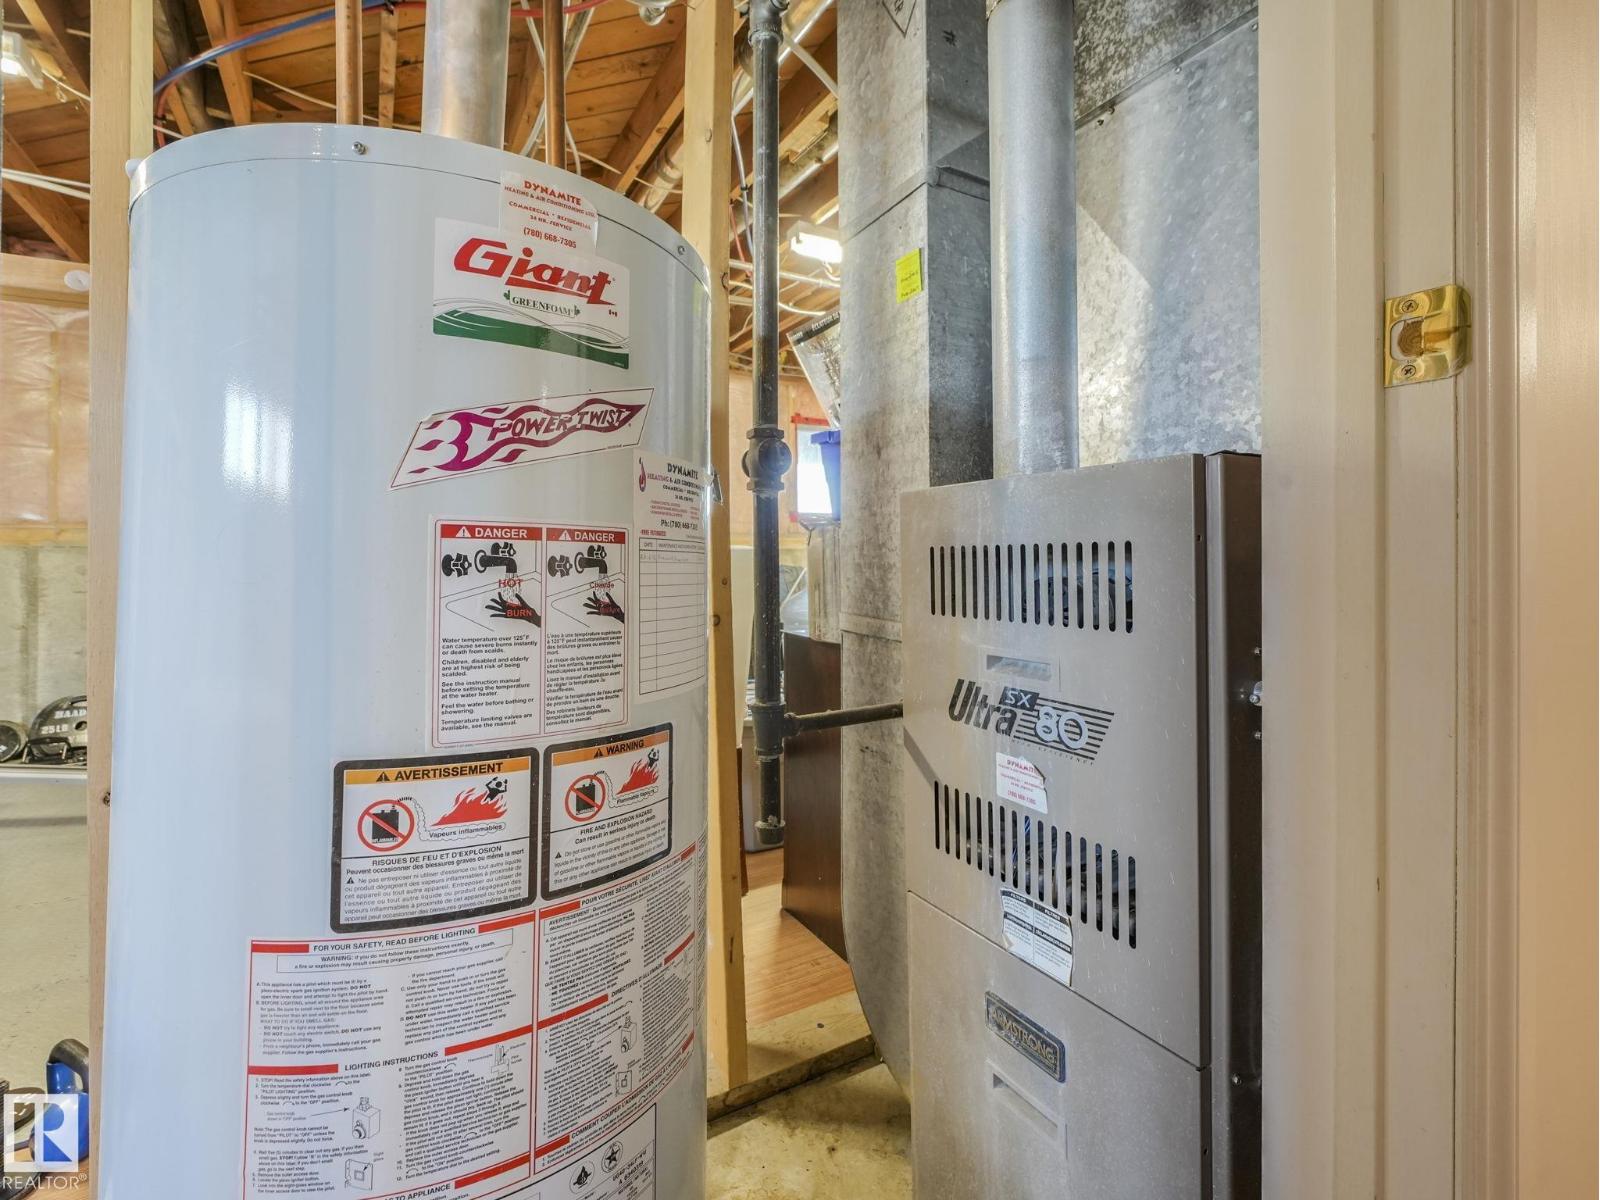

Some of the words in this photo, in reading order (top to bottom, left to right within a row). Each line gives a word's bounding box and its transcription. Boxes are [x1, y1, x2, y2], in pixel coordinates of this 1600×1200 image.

[505, 186, 529, 197] HEATING
[524, 181, 581, 205] DYNAMITE
[509, 201, 549, 216] COMMERCIAL
[524, 227, 542, 240] (780)
[549, 221, 572, 231] SERVICE
[454, 237, 615, 306] Giant
[512, 295, 573, 316] GREENFOAM
[487, 415, 574, 441] POWER
[576, 409, 624, 429] TWIST
[668, 463, 698, 479] DYNAMITE
[475, 528, 527, 538] DANGER
[575, 532, 615, 542] DANGER
[506, 609, 532, 617] BURN
[1004, 690, 1032, 707] SX
[949, 679, 1018, 737] Ultra
[1034, 706, 1088, 749] 80
[606, 740, 644, 755] WARNING
[394, 762, 504, 781] AVERTISSEMENT
[580, 827, 593, 835] FIRE
[594, 824, 606, 832] AND
[607, 816, 635, 828] EXPLOSION
[636, 809, 653, 818] HAZARD
[429, 830, 456, 839] Vapeurs
[458, 824, 503, 835] inflammables
[587, 833, 603, 842] result
[610, 827, 626, 835] serious
[372, 858, 407, 866] RISQUES
[452, 846, 501, 858] D'EXPLOSION
[373, 865, 411, 873] occasionner
[426, 860, 454, 868] blessures
[581, 896, 598, 906] POUR
[596, 888, 615, 901] VOTRE
[353, 941, 384, 949] SAFETY,
[408, 934, 439, 943] BEFORE
[441, 928, 475, 939] LIGHTING
[420, 945, 450, 953] instructions
[992, 1010, 1058, 1064] ARMSTRONG
[344, 1060, 381, 1071] LIGHTING
[382, 1051, 439, 1067] INSTRUCTIONS
[571, 1119, 600, 1138] COMMENT
[600, 1106, 622, 1122] COUPER
[407, 1184, 451, 1200] APPLIANCE
